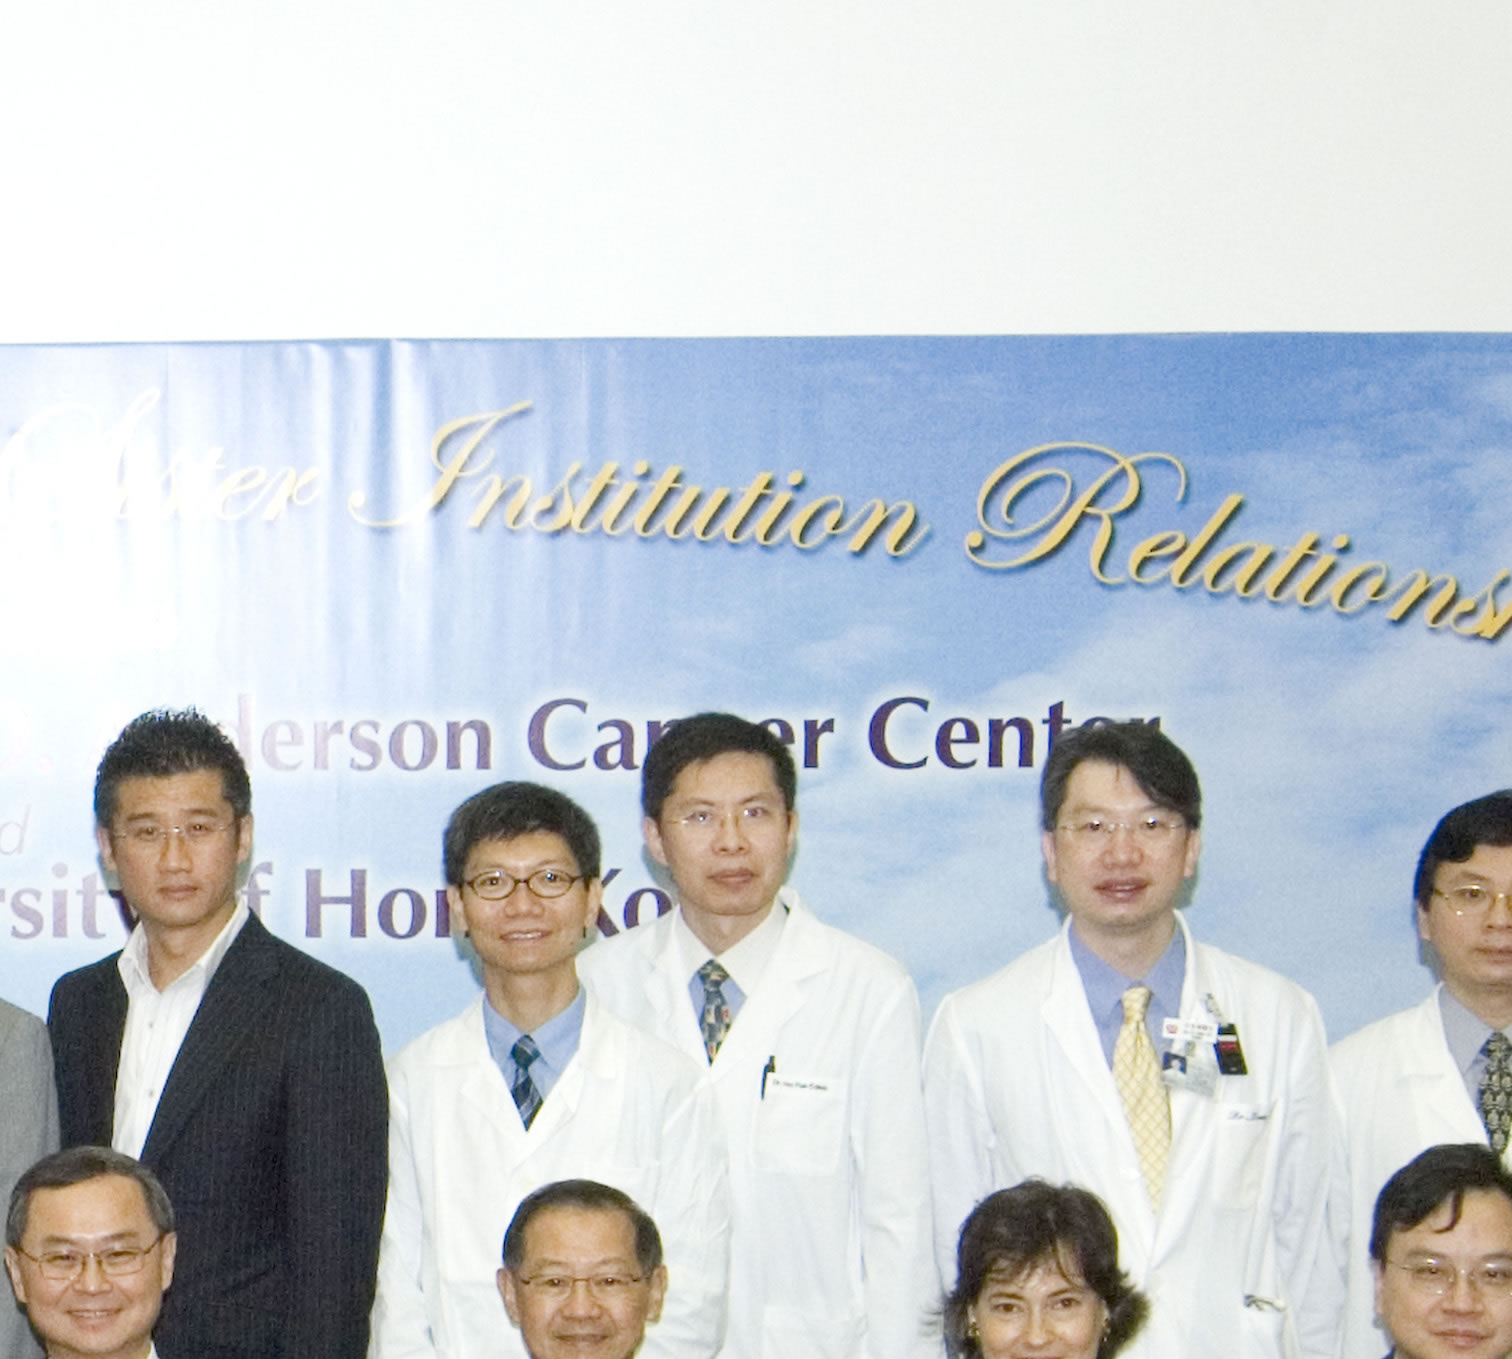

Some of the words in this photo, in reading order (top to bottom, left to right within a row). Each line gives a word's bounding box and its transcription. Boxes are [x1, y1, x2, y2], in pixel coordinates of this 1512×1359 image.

[349, 400, 926, 556] Institution
[88, 695, 491, 771] derson
[528, 698, 834, 770] Car
[869, 697, 1161, 769] Cent
[305, 868, 468, 938] Ho
